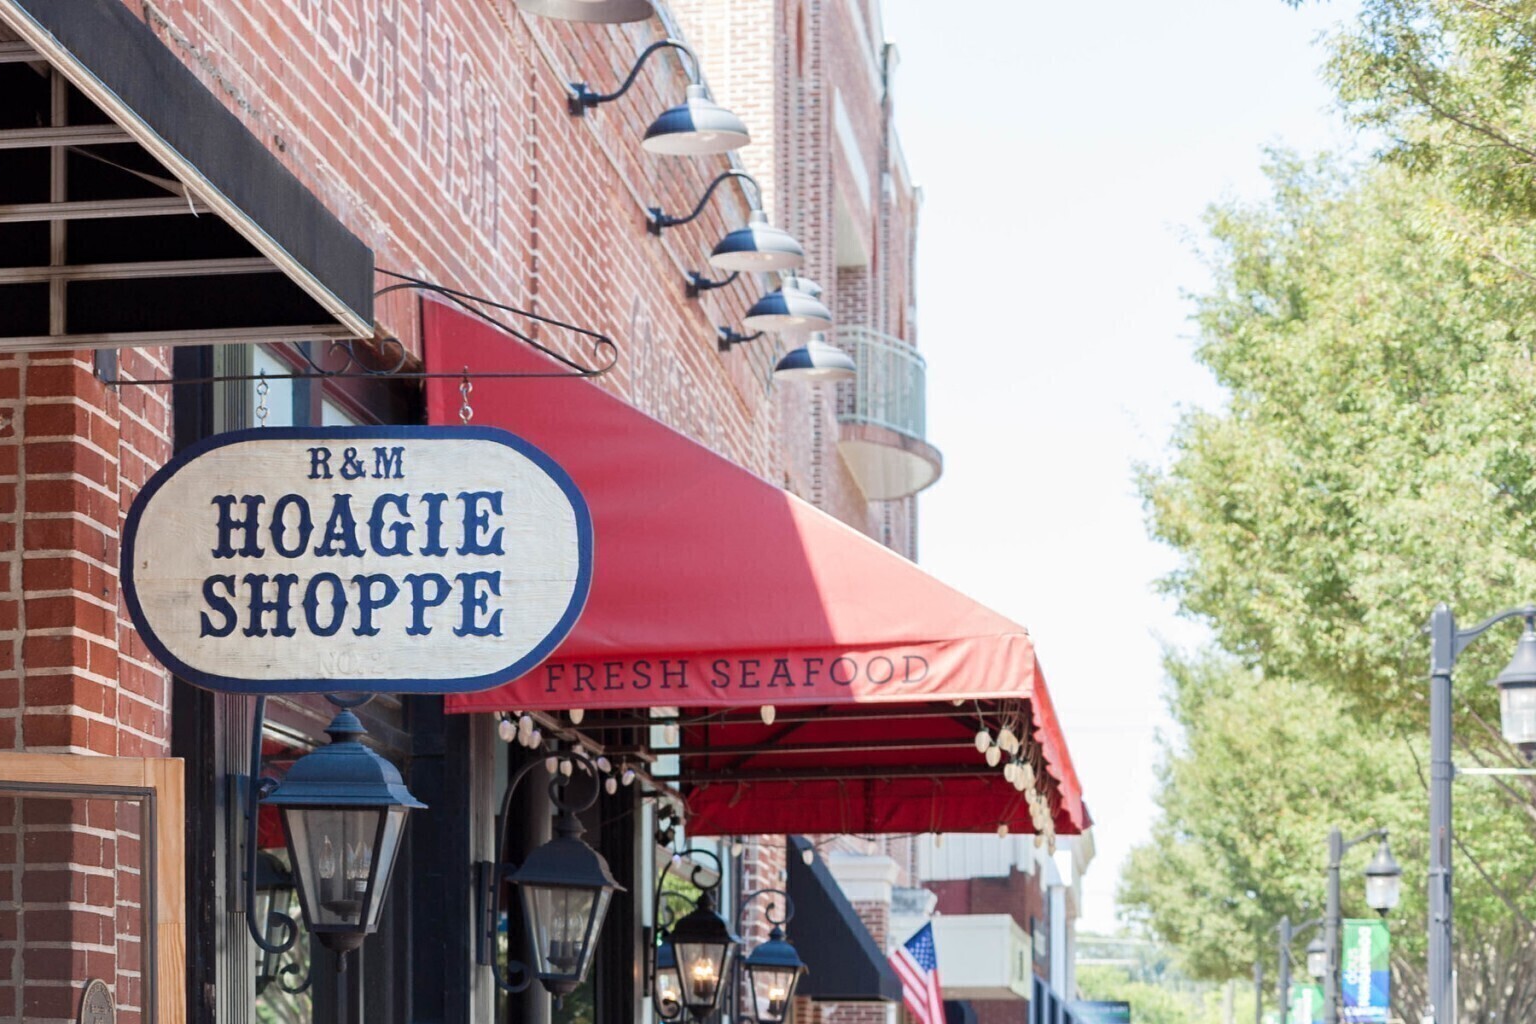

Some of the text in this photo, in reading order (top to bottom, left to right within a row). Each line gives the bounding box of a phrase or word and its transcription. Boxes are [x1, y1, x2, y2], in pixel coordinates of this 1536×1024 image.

[307, 446, 406, 480] R&M
[211, 490, 506, 559] HOAGIE
[199, 570, 504, 639] SHOPPE
[544, 654, 929, 693] FRESH SEAFOOD
